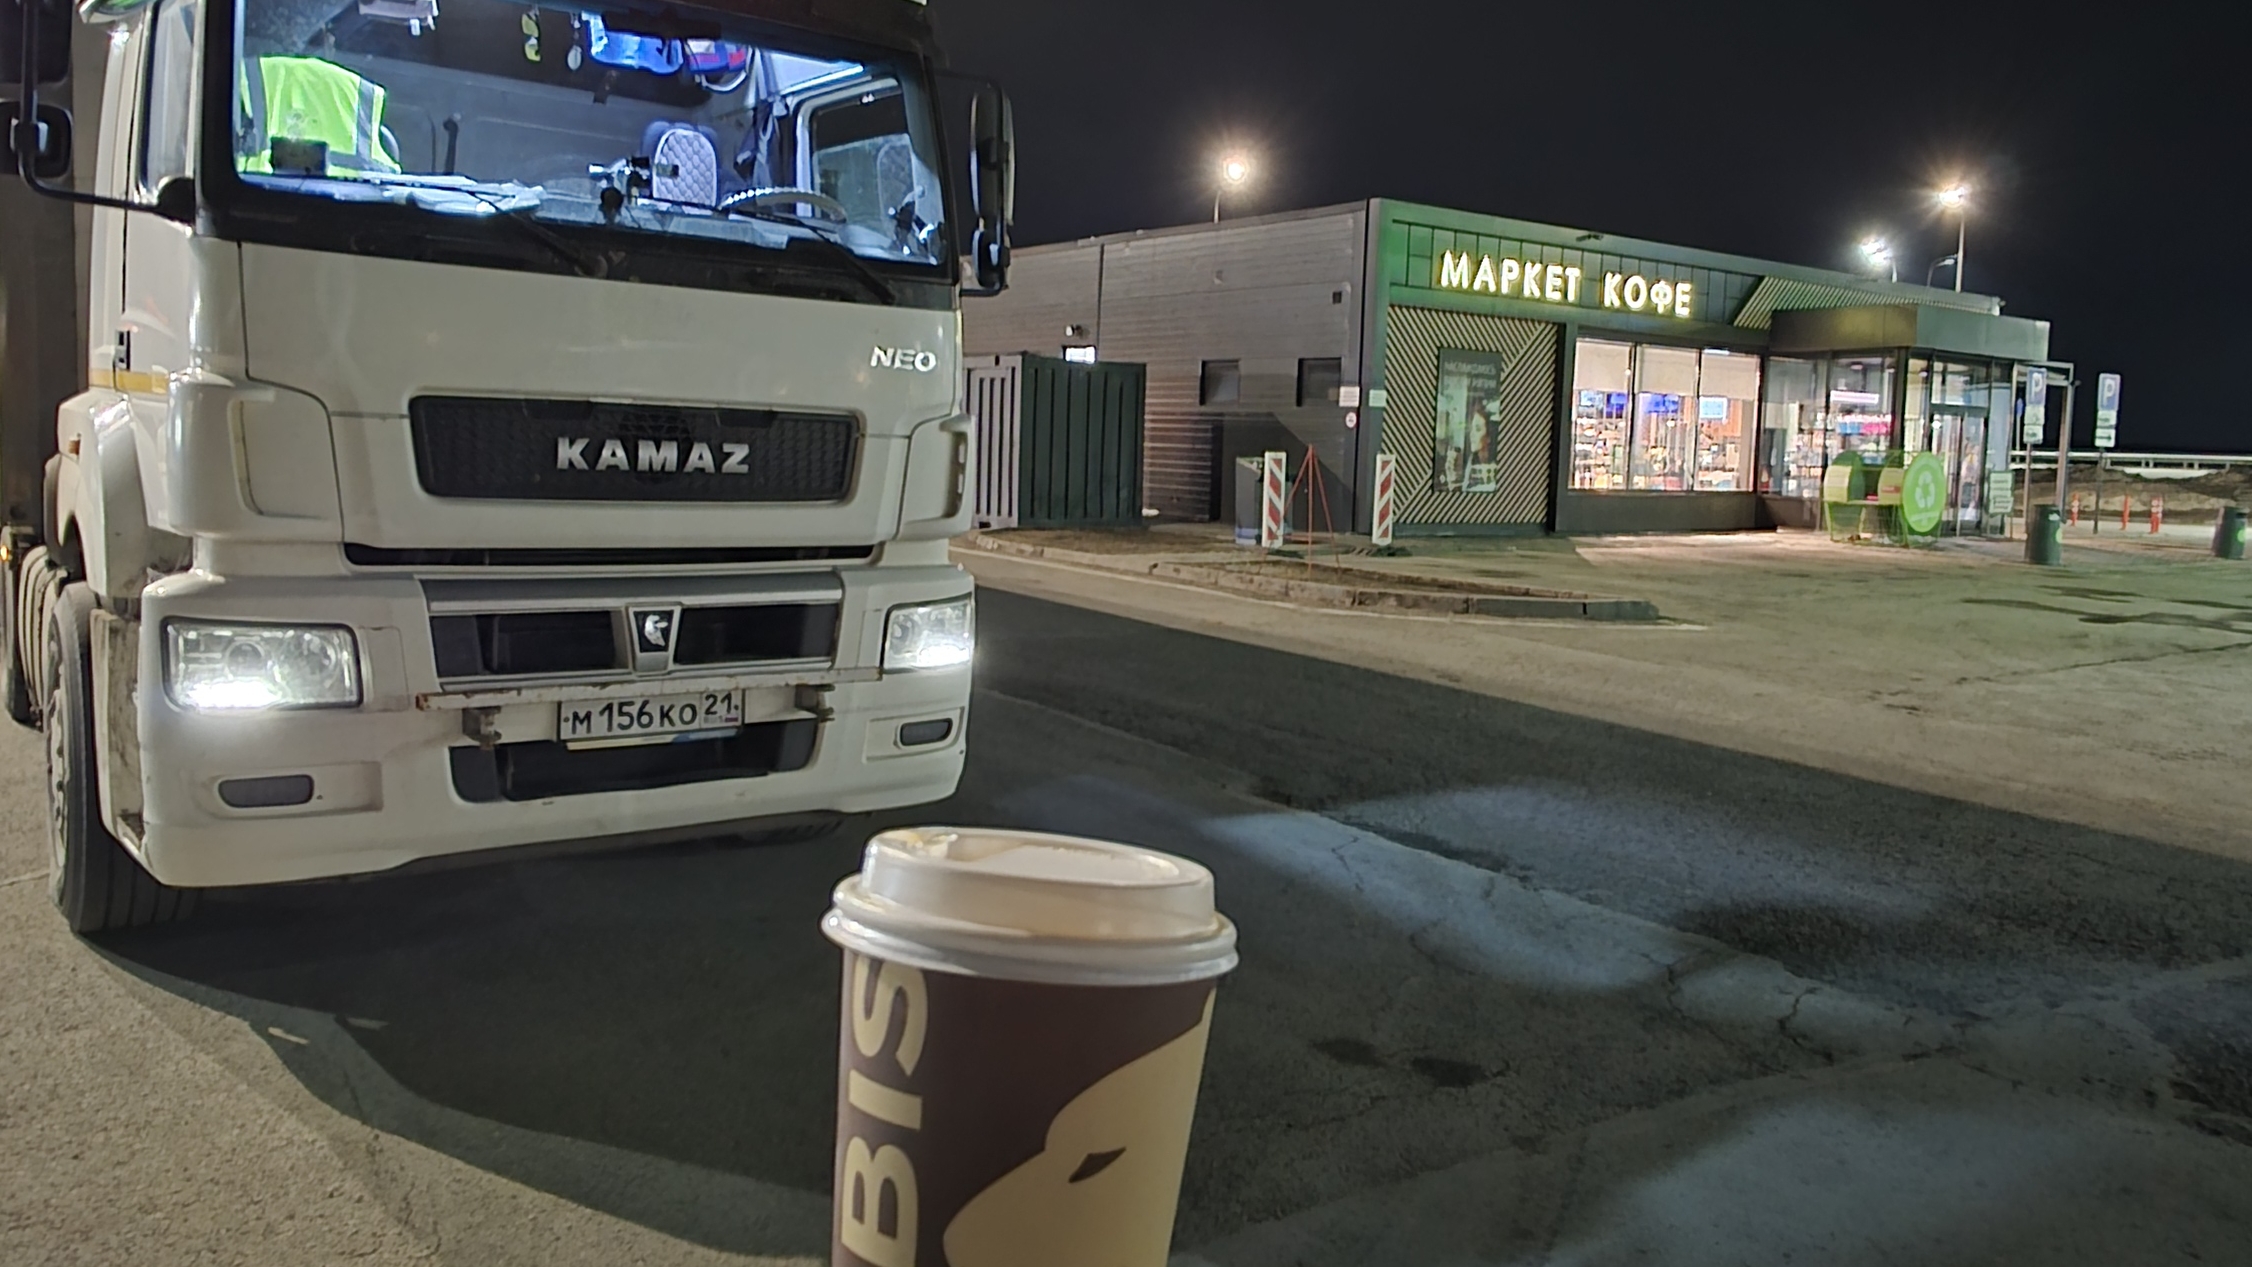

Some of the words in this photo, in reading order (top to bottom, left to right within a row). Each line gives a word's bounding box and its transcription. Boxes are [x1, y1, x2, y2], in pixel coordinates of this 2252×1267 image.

[1440, 249, 1582, 303] МАРКЕТ
[1603, 271, 1693, 318] КОФЕ
[870, 345, 937, 372] NEO
[2103, 378, 2116, 407] P
[556, 436, 750, 474] KAMAZ
